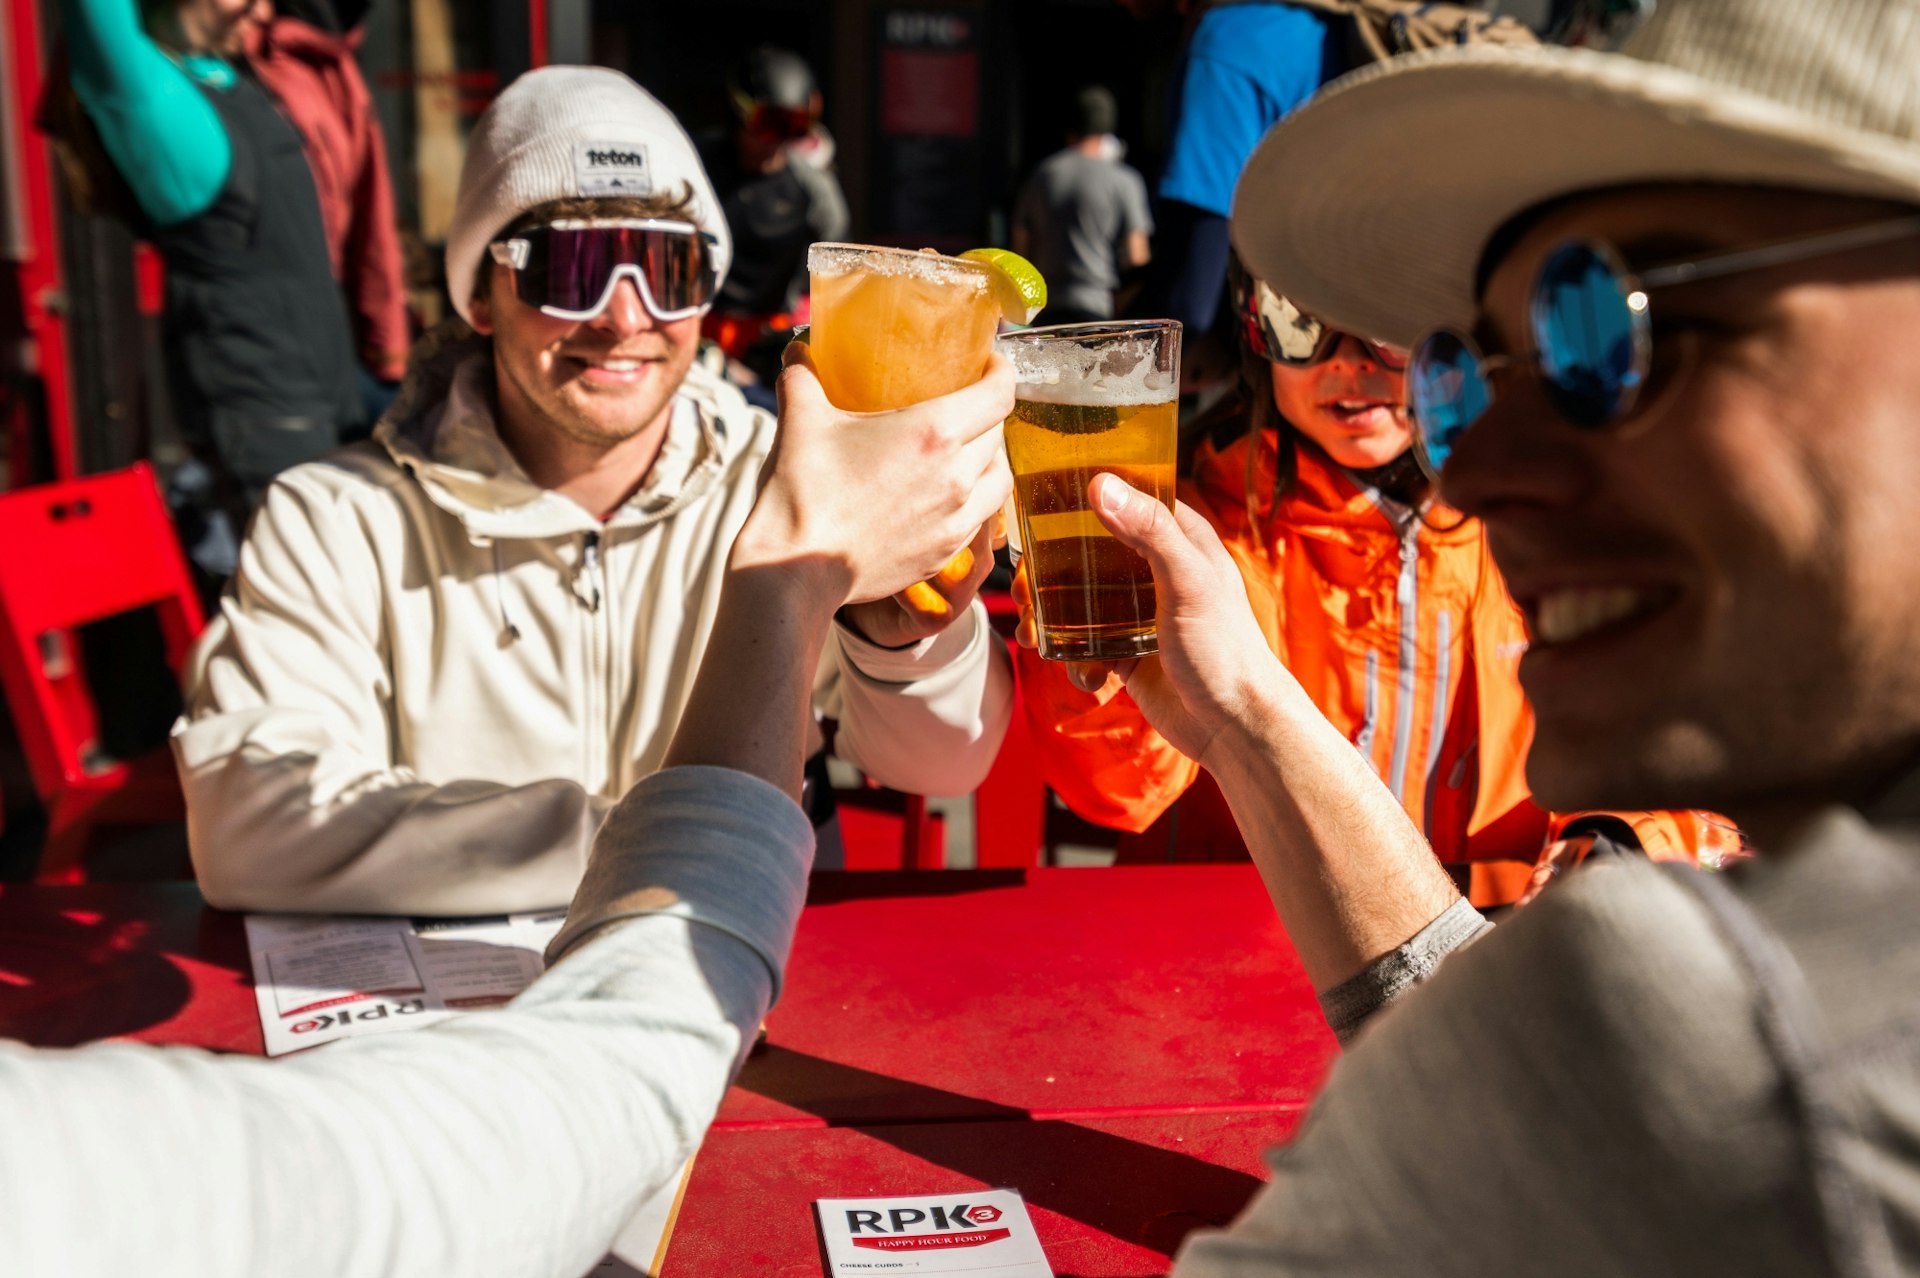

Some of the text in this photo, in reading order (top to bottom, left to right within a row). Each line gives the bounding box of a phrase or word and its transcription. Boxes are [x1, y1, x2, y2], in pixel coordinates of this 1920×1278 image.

[586, 149, 642, 166] teton
[918, 1237, 951, 1245] HOUR
[955, 1235, 987, 1243] FOOD
